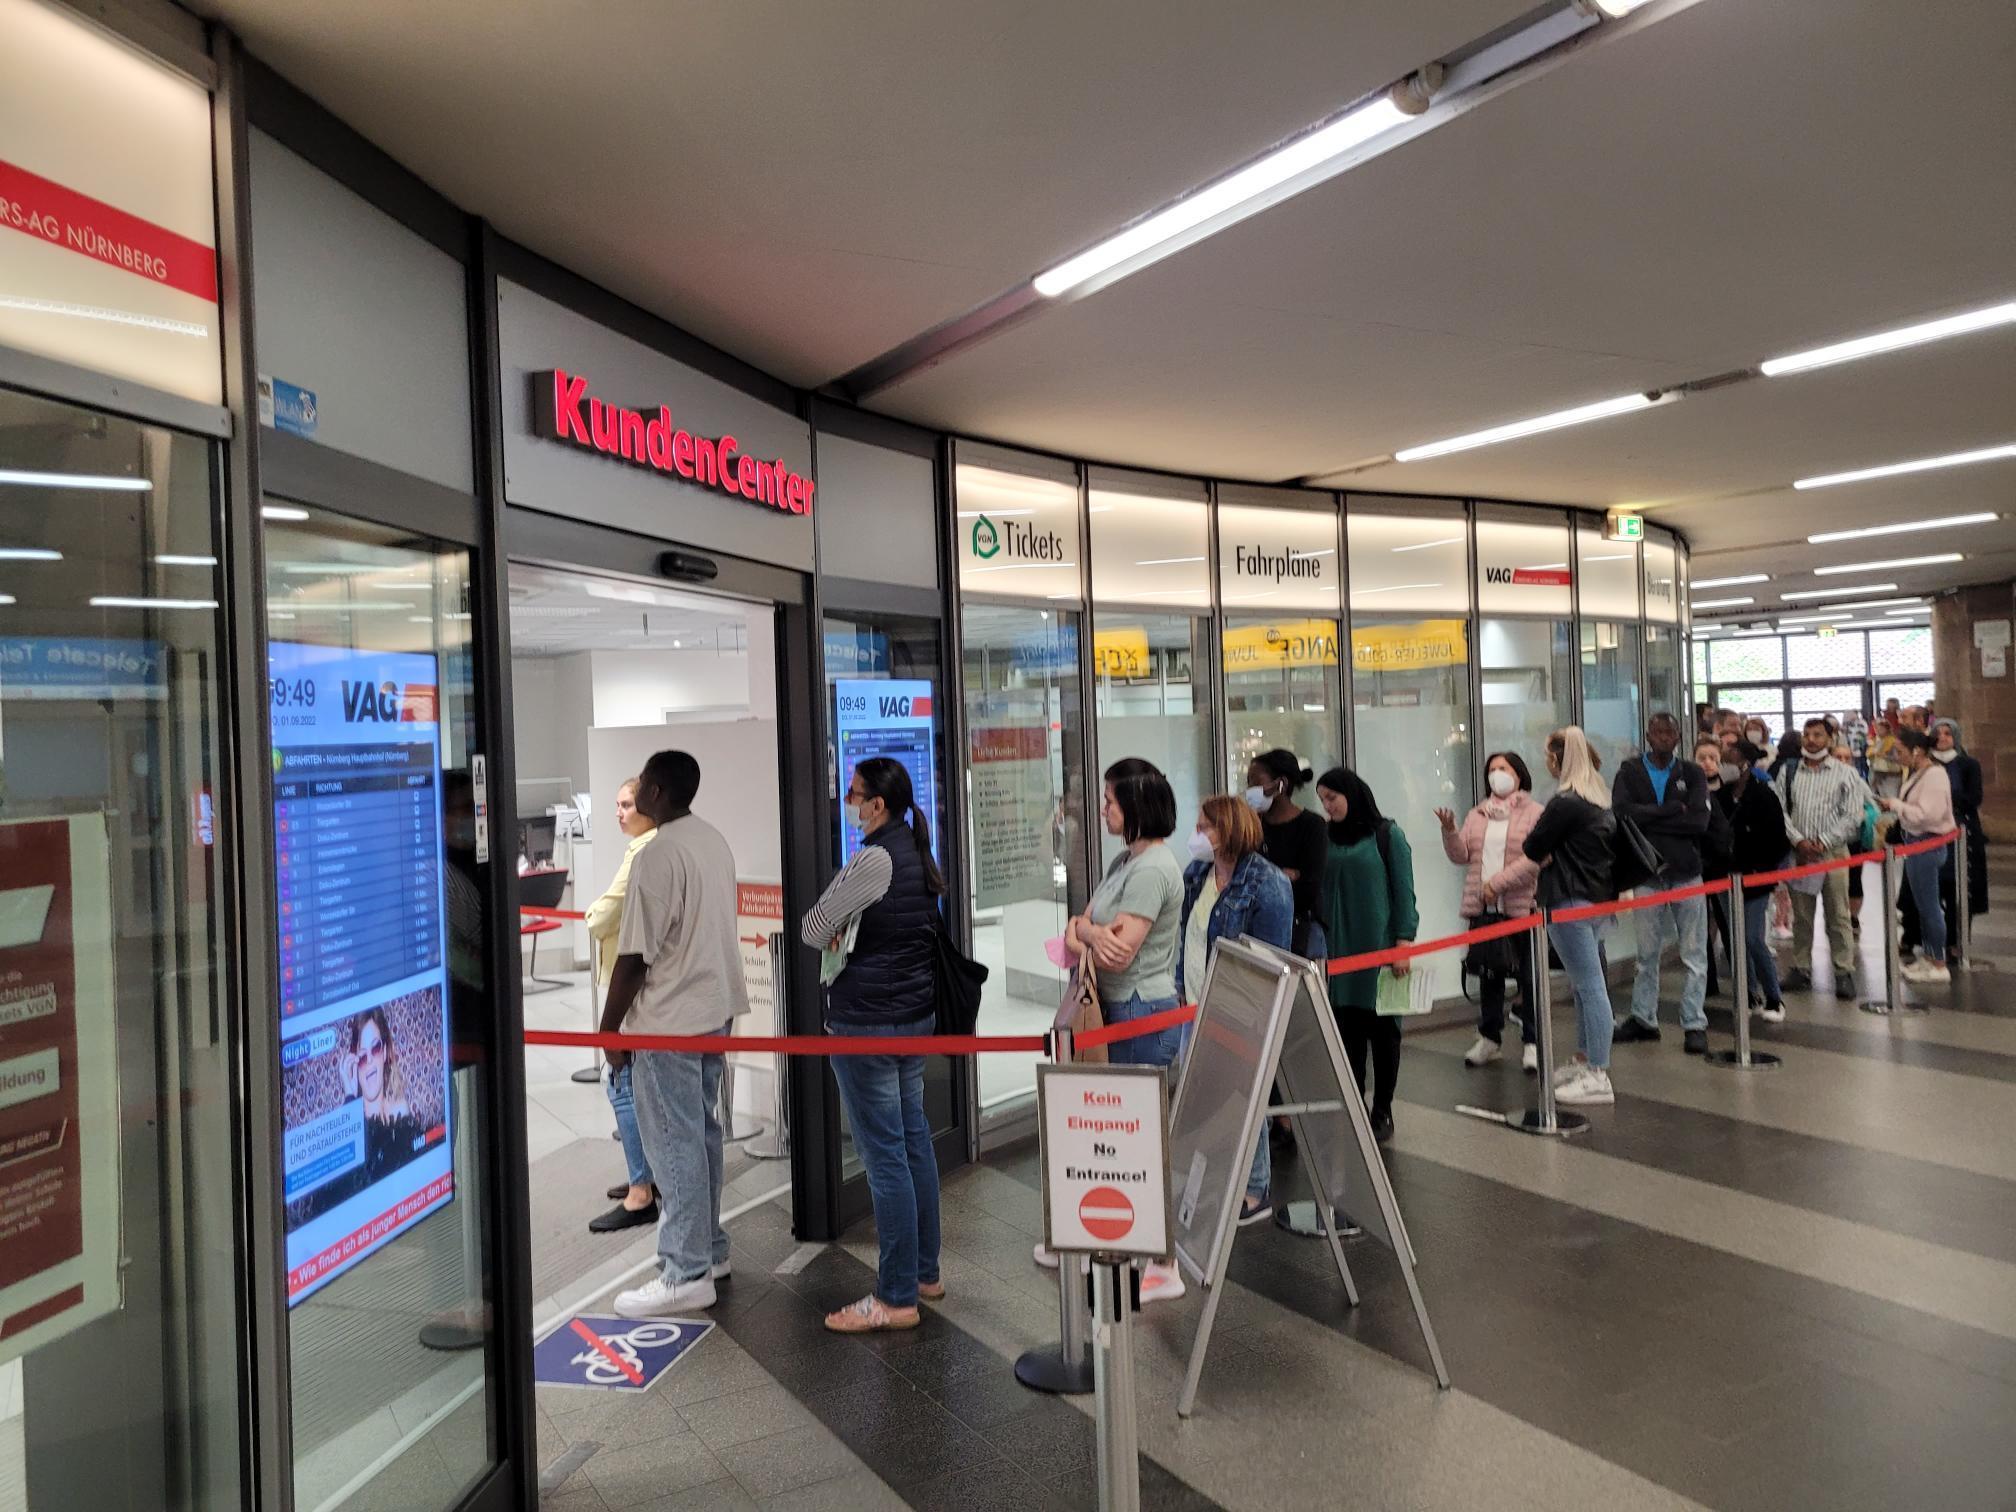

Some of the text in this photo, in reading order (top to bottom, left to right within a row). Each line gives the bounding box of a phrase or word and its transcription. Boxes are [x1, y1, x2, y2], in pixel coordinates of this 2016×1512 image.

[66, 223, 167, 280] NÜRNBERG
[554, 368, 814, 516] KundenCenter
[1003, 520, 1063, 561] Tickets
[1237, 545, 1321, 583] Fahrpläne
[1486, 567, 1511, 584] VAG
[342, 680, 399, 723] VAG
[840, 696, 910, 718] 09:49 VAG
[285, 1034, 333, 1061] Night Liner
[1083, 1090, 1122, 1106] Kein
[290, 1113, 351, 1149] FÜR NACHTEULEN
[1067, 1116, 1141, 1134] Eingang!
[291, 1150, 307, 1165] UND
[1093, 1143, 1116, 1157] No
[1066, 1166, 1147, 1182] Entrance!
[299, 1265, 317, 1284] Wie
[318, 1248, 341, 1271] finde
[343, 1238, 356, 1255] ich
[357, 1229, 370, 1245] als
[371, 1214, 396, 1240] junger
[398, 1192, 426, 1219] Mensch
[427, 1183, 440, 1201] den
